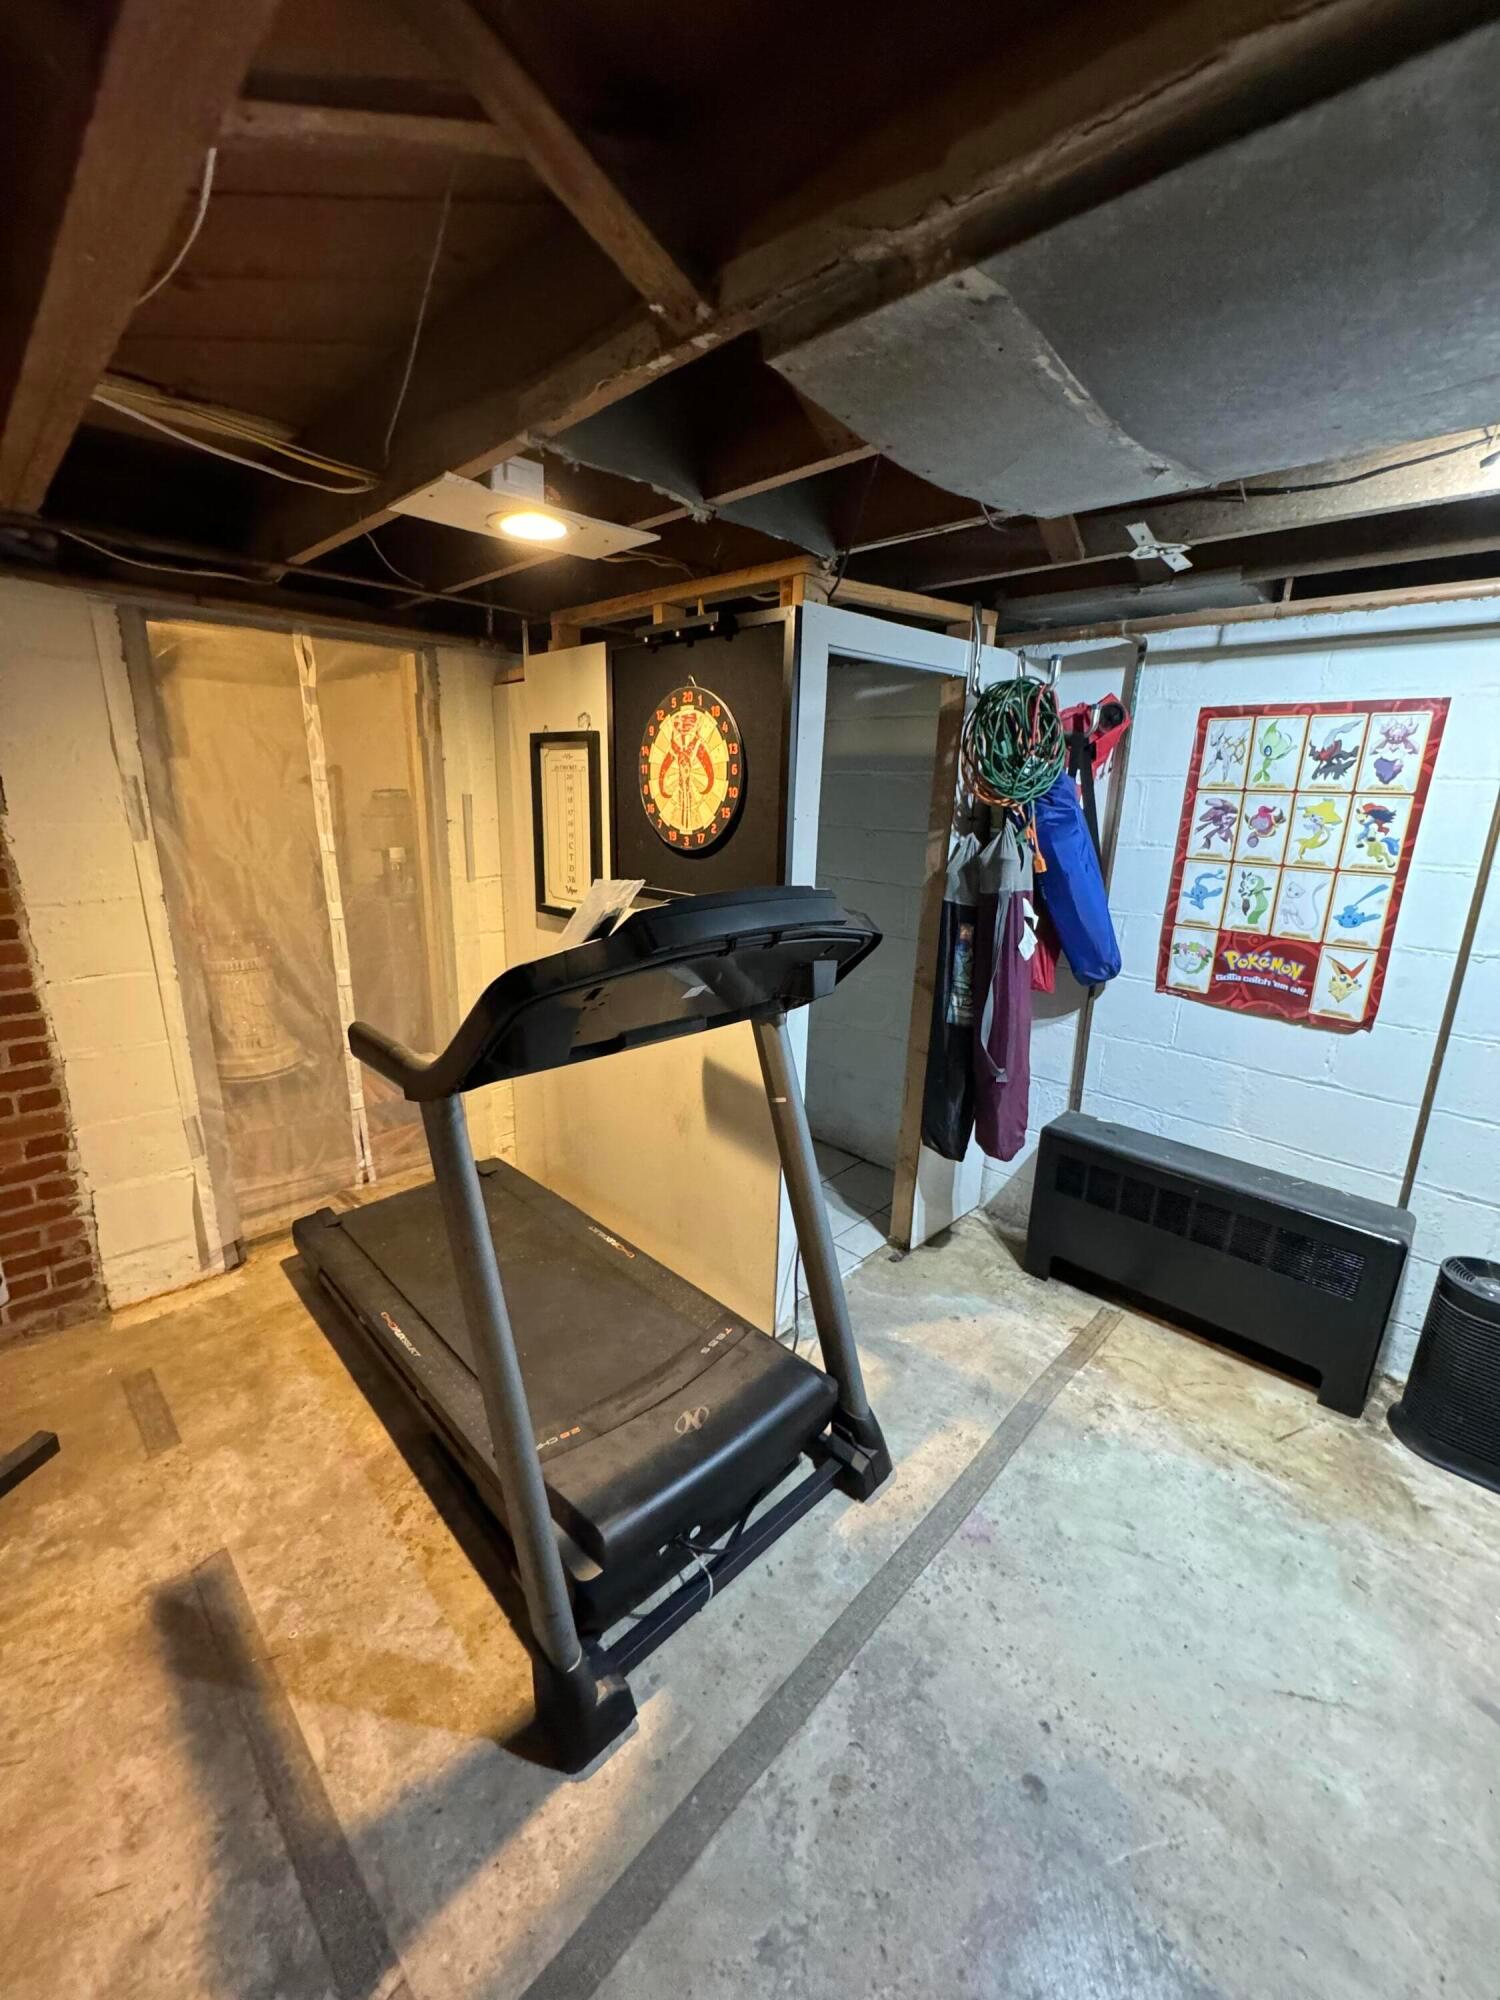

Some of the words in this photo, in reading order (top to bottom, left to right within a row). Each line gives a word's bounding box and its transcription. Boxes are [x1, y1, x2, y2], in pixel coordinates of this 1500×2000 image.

[682, 691, 693, 702] 20
[698, 694, 702, 706] 1
[671, 697, 677, 708] 5
[656, 710, 664, 720] 12
[711, 705, 720, 717] 18
[649, 726, 654, 736] 9
[722, 721, 728, 733] 4
[641, 745, 649, 756] 14
[729, 743, 738, 754] 13
[641, 764, 648, 774] 11
[732, 764, 737, 775] 6
[728, 787, 738, 798] 10
[647, 803, 655, 814] 16
[721, 807, 730, 818] 15
[657, 820, 662, 828] 7
[711, 823, 717, 834] 2
[668, 831, 677, 841] 19
[684, 836, 689, 846] 3
[697, 833, 705, 844] 17
